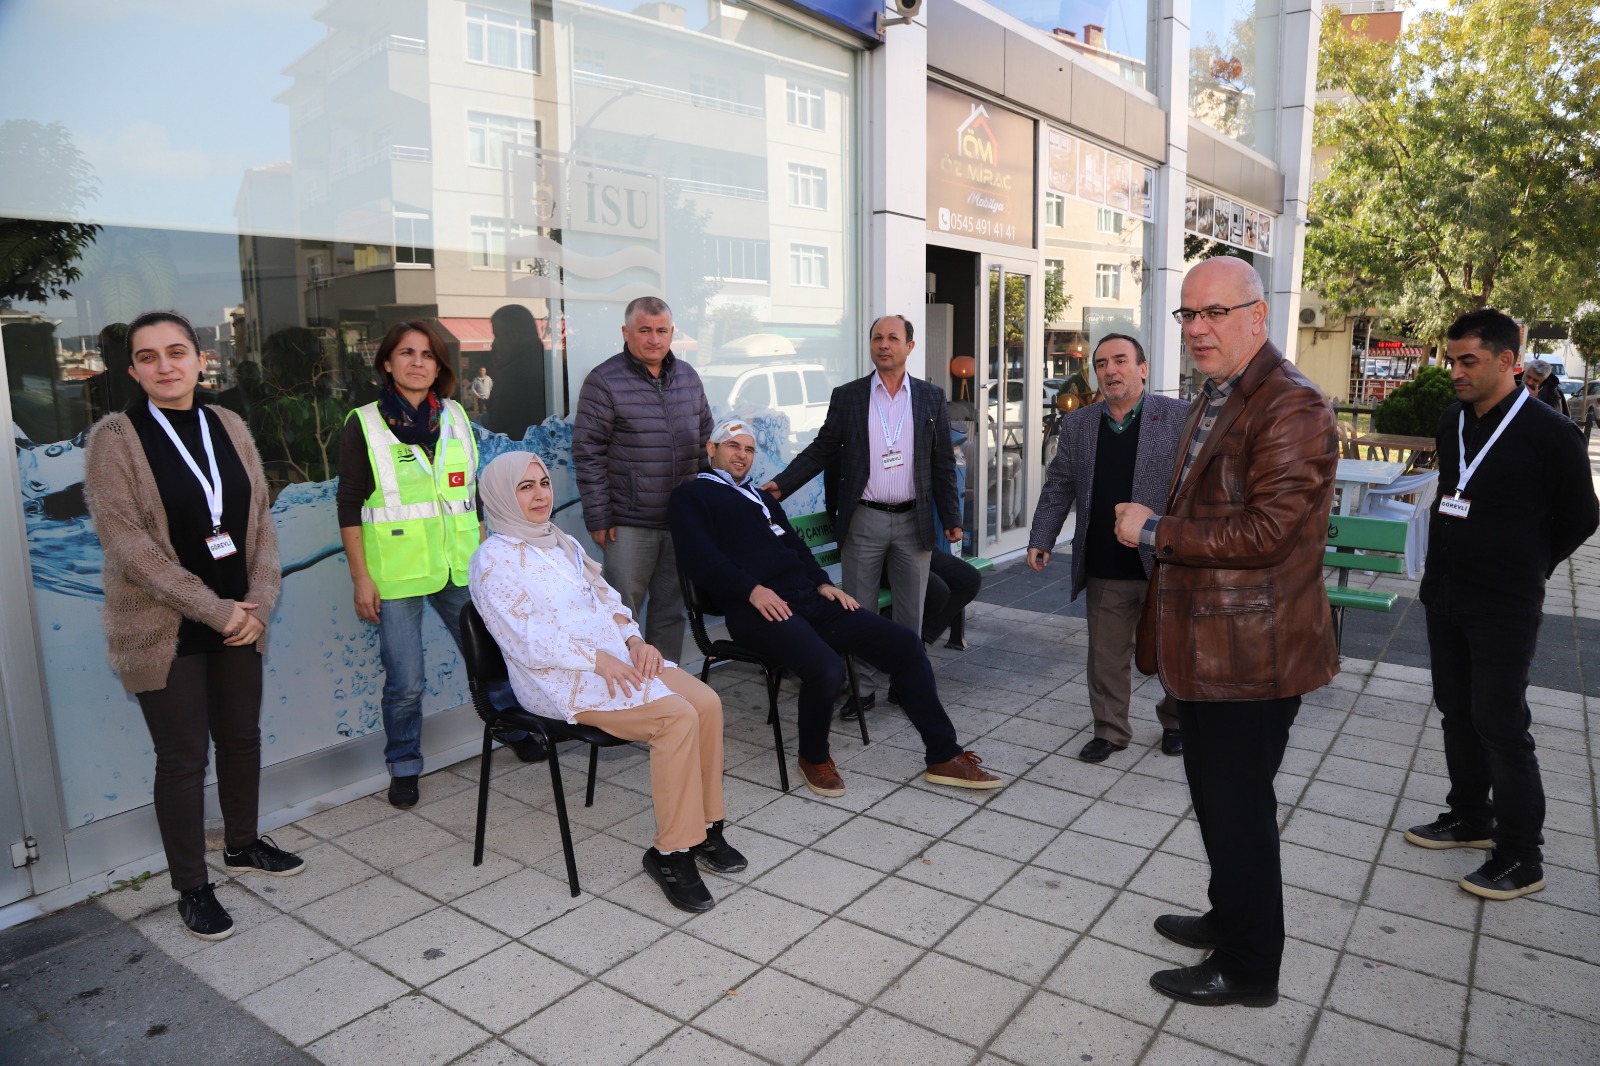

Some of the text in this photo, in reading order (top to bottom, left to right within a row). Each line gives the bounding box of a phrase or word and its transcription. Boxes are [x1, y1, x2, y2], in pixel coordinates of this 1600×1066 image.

[583, 171, 649, 230] İSU
[967, 191, 1005, 213] Mobilya
[950, 212, 1016, 240] 0545 491 41 41
[1441, 500, 1468, 512] GÖREVLİ
